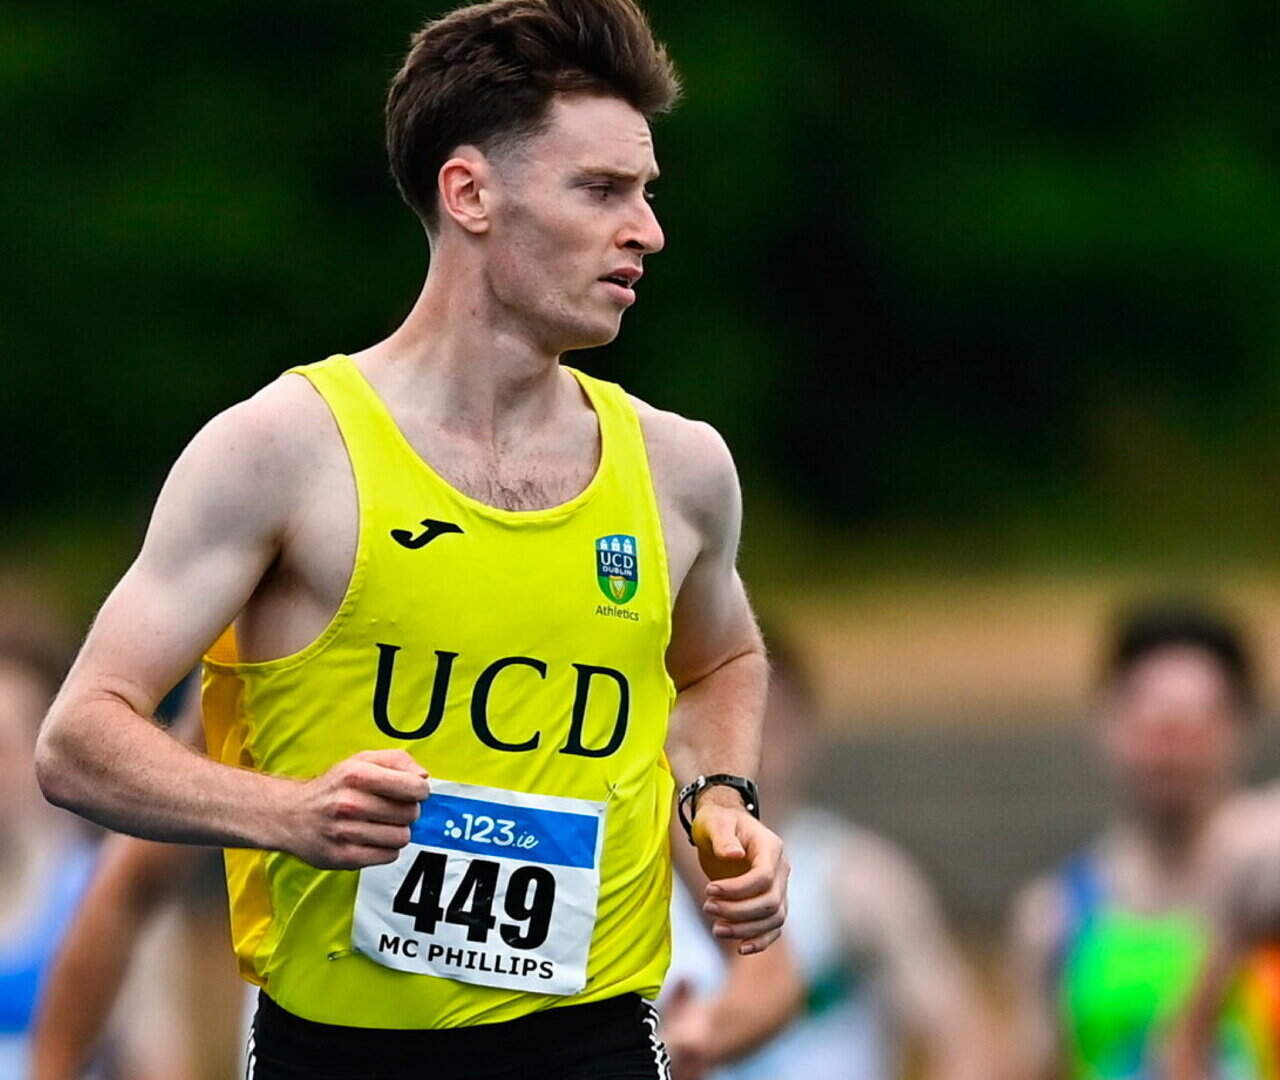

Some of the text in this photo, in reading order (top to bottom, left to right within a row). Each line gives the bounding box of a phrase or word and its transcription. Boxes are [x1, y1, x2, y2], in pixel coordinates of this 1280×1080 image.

[600, 551, 634, 570] UCD
[602, 565, 633, 577] DUBLIN
[595, 604, 640, 622] Athletics
[372, 642, 631, 759] UCD
[392, 850, 556, 950] 449
[378, 933, 554, 980] MC PHILLIPS
